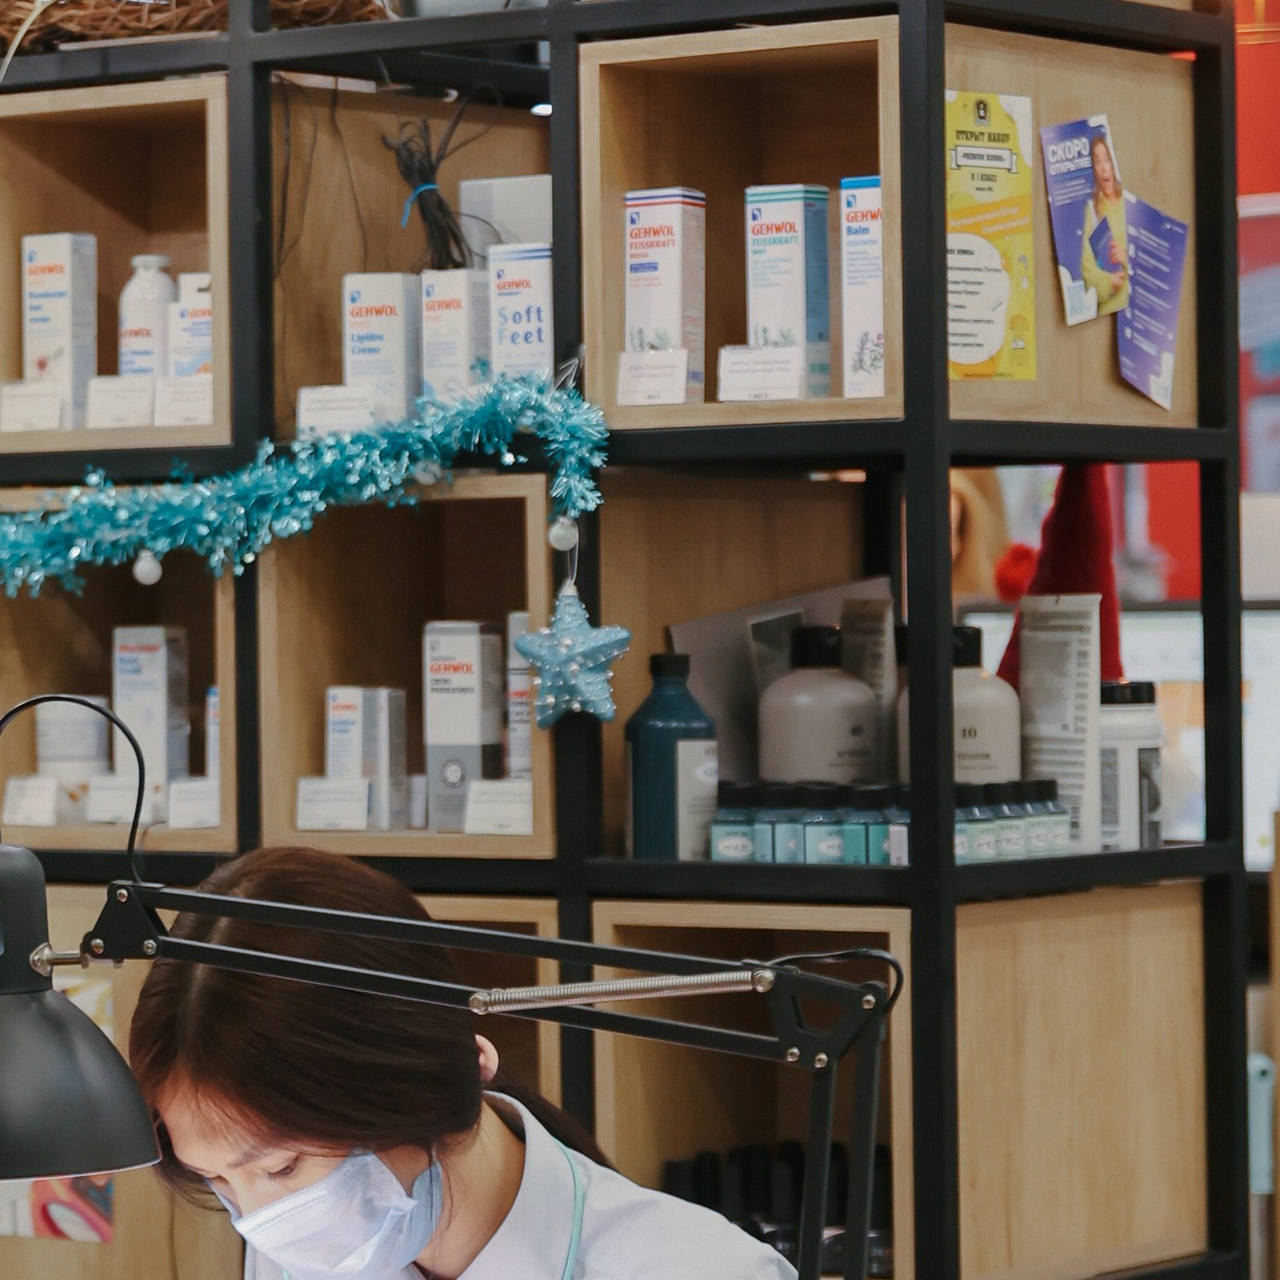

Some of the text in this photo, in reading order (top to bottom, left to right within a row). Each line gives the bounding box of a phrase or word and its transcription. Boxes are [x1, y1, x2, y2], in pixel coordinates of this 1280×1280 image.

[1049, 137, 1091, 163] СКОРО
[846, 208, 882, 223] GEHW
[630, 225, 676, 239] GEHWOL
[751, 221, 799, 235] GEHWOL
[846, 225, 870, 236] Balm
[630, 238, 676, 250] FUSSKRAFT
[752, 236, 798, 246] FUSSKRAFT
[497, 279, 532, 291] GEHWOL
[350, 304, 399, 318] GEHWOL
[426, 298, 464, 312] GEHWOL
[498, 305, 544, 325] Soft
[498, 327, 545, 345] Feet
[430, 662, 474, 675] GEHWOL
